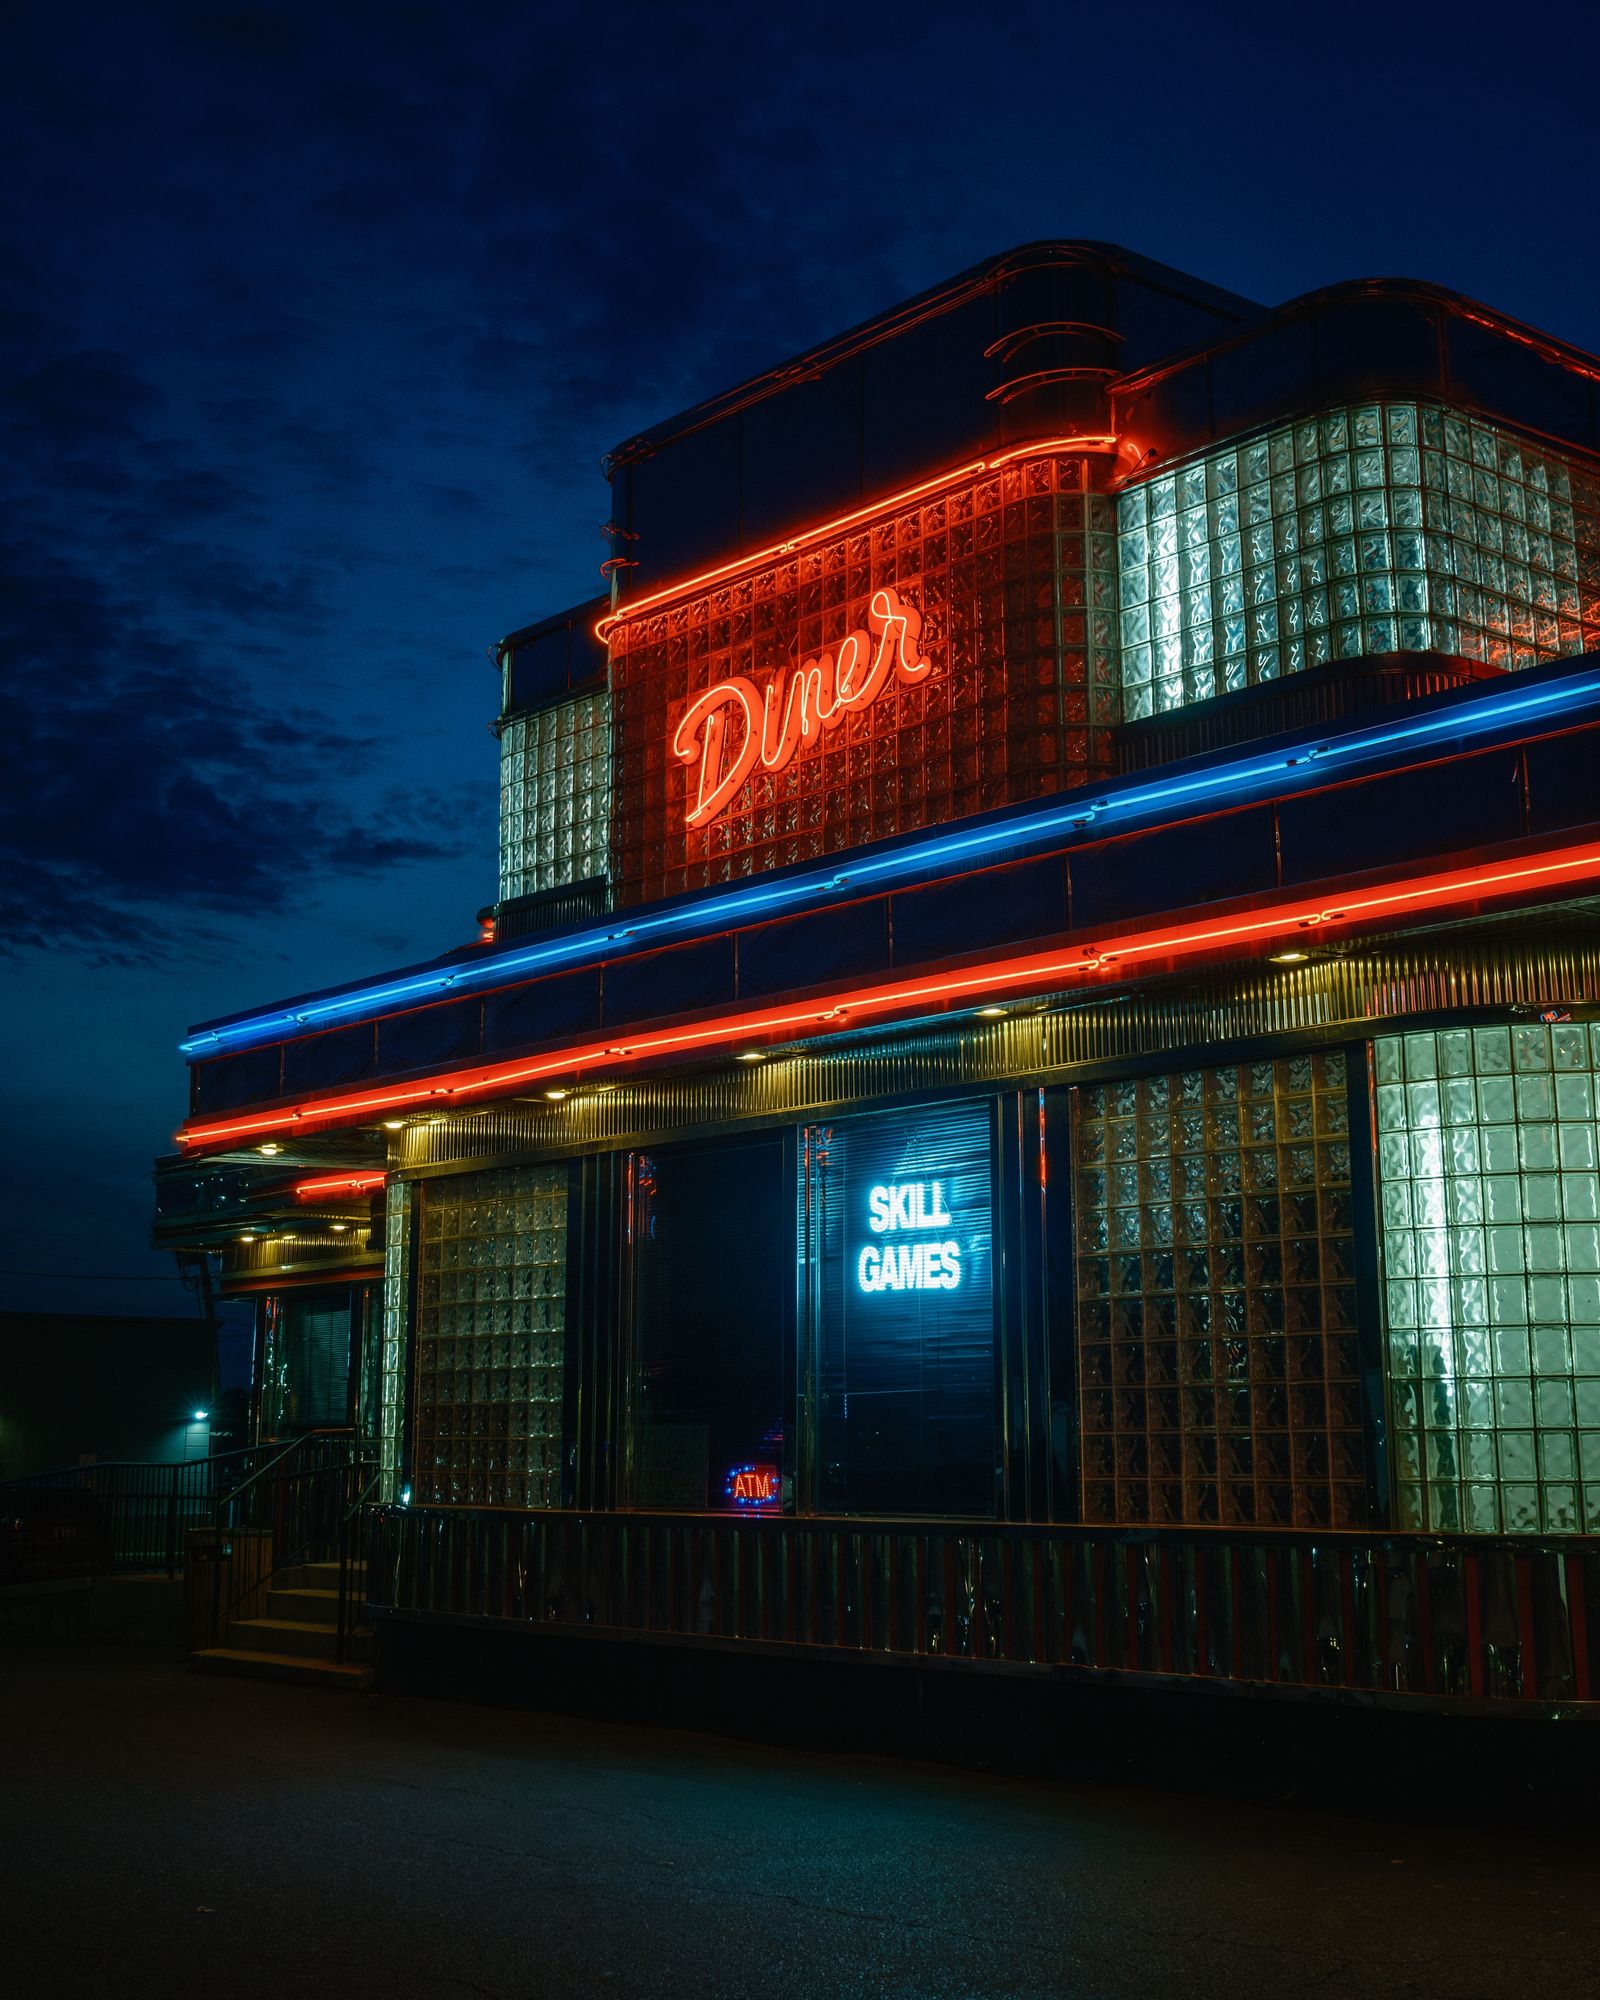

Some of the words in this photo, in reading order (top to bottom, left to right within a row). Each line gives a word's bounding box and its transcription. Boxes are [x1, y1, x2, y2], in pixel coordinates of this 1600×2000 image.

[673, 587, 932, 828] Diner
[869, 1181, 951, 1232] SKILL
[857, 1241, 962, 1293] GAMES
[734, 1474, 770, 1498] ATM
